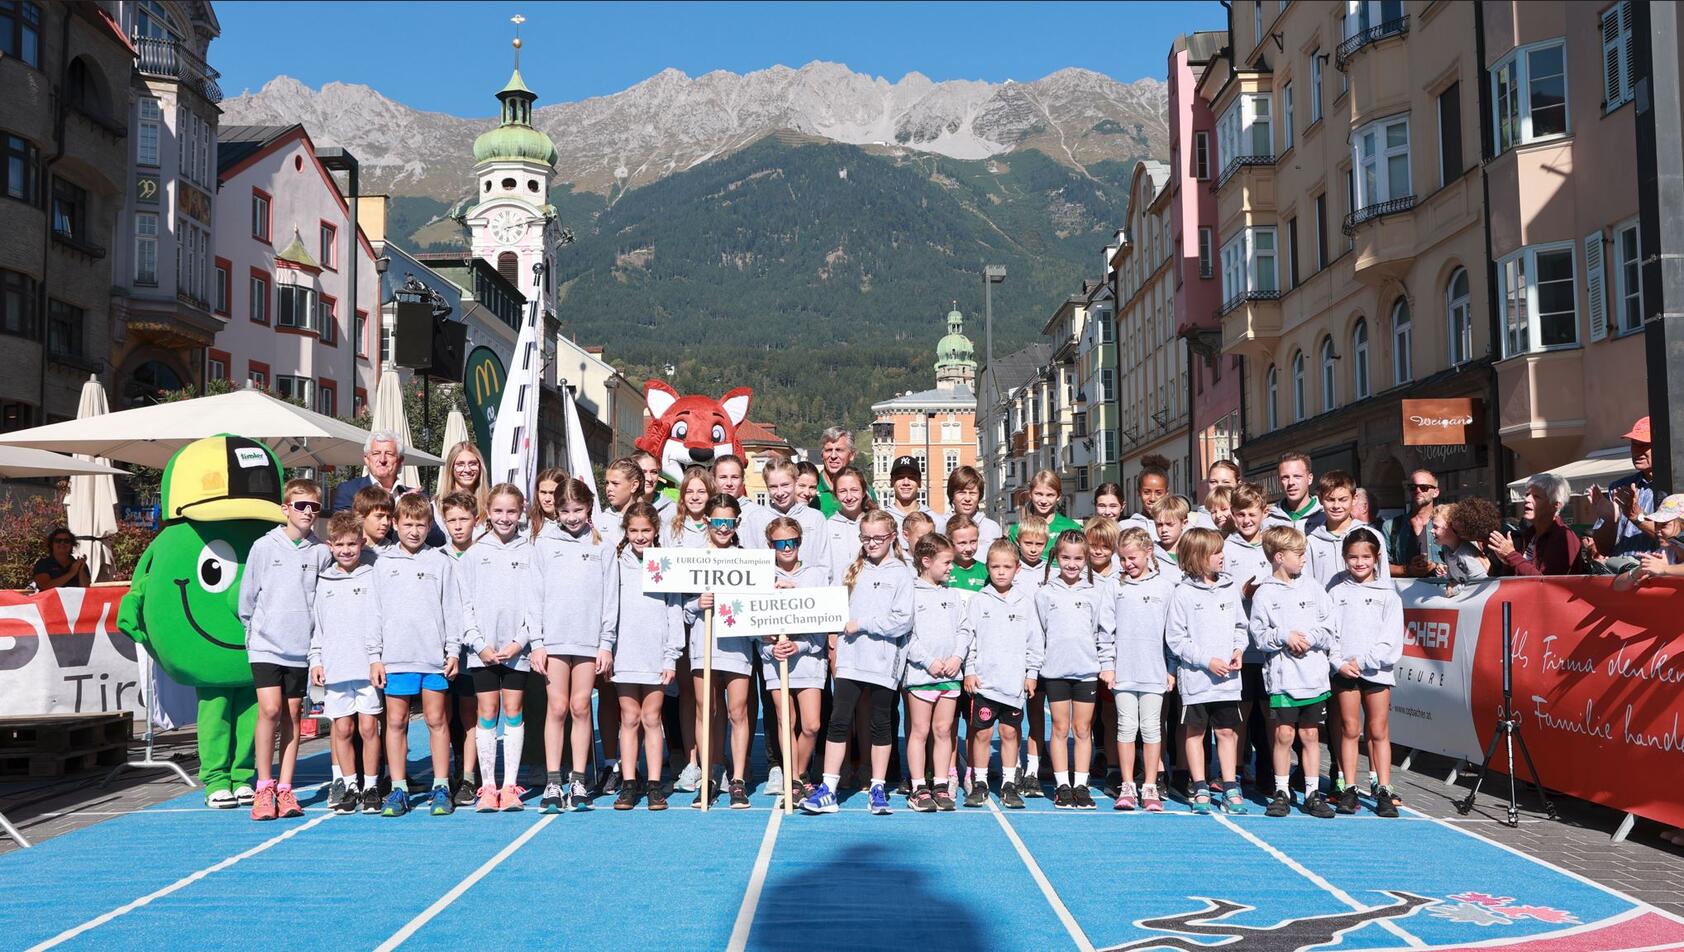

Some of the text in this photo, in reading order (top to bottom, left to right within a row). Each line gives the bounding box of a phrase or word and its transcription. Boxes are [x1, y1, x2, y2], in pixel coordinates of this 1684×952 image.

[1410, 415, 1473, 428] Weigand
[676, 556, 771, 566] EUREGIO SprintChampion
[689, 569, 756, 586] TIROL
[750, 597, 843, 629] EUREGIO SprintChampion
[1542, 635, 1596, 674] Firma
[64, 673, 146, 713] Tir
[1531, 695, 1613, 740] Familie
